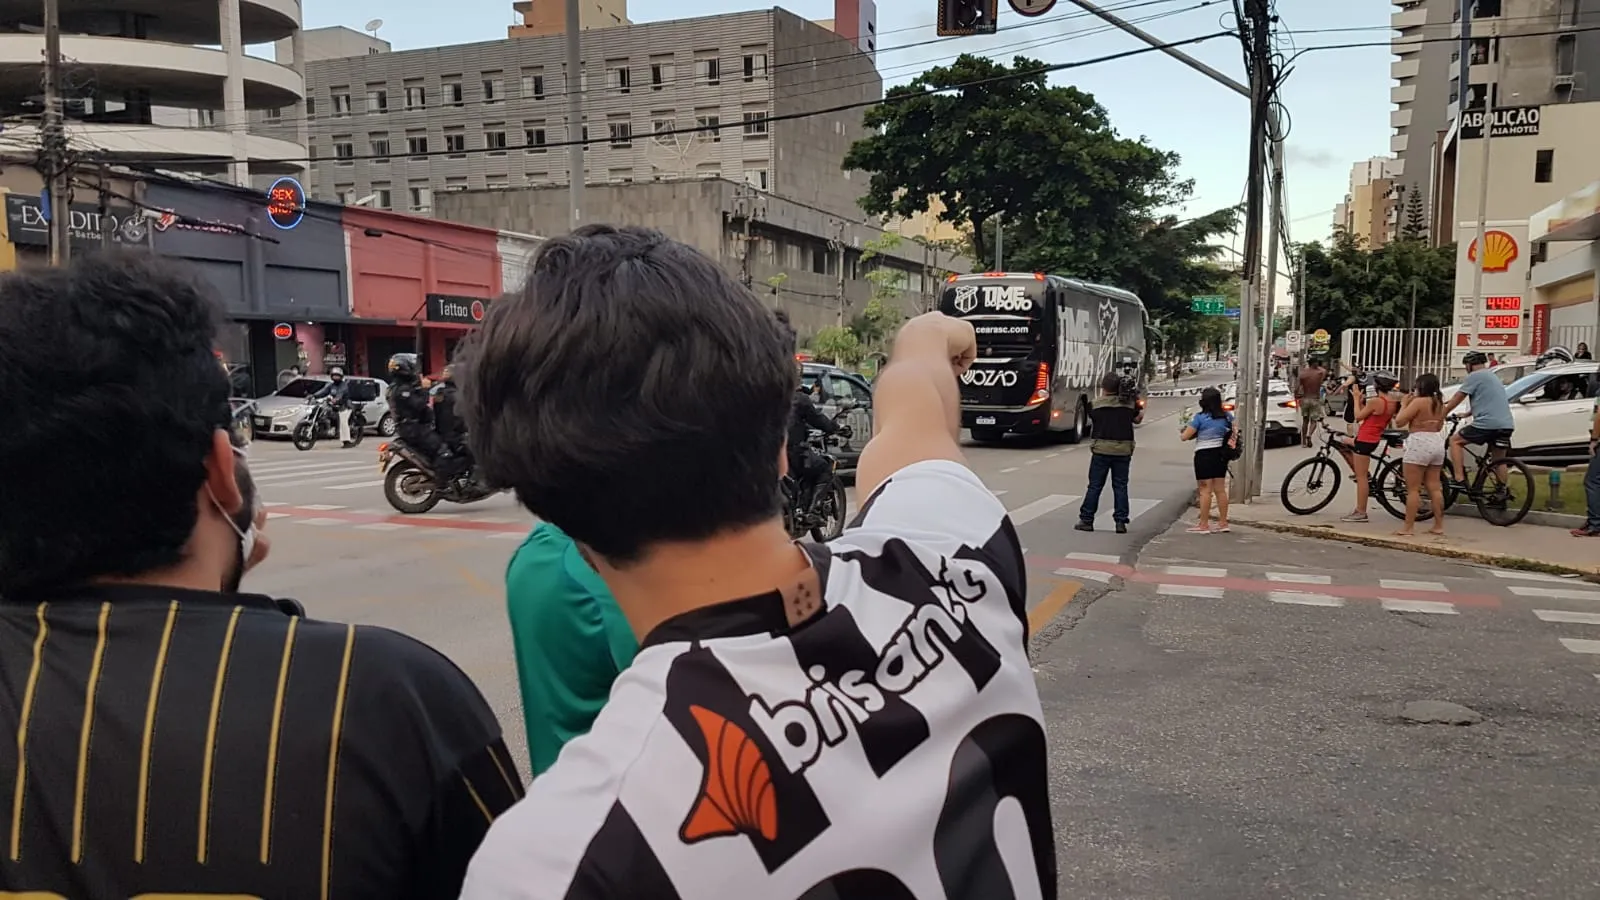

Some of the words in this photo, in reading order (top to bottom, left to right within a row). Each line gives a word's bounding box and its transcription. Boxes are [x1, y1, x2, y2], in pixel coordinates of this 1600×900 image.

[1479, 127, 1509, 136] PAIA
[1509, 125, 1539, 134] HOTEL
[272, 188, 294, 200] SEX
[22, 205, 119, 233] EXDIT
[982, 286, 1026, 301] TIME
[438, 299, 468, 317] Tattoo
[996, 299, 1033, 311] POVO
[975, 326, 1029, 334] cearasc.com
